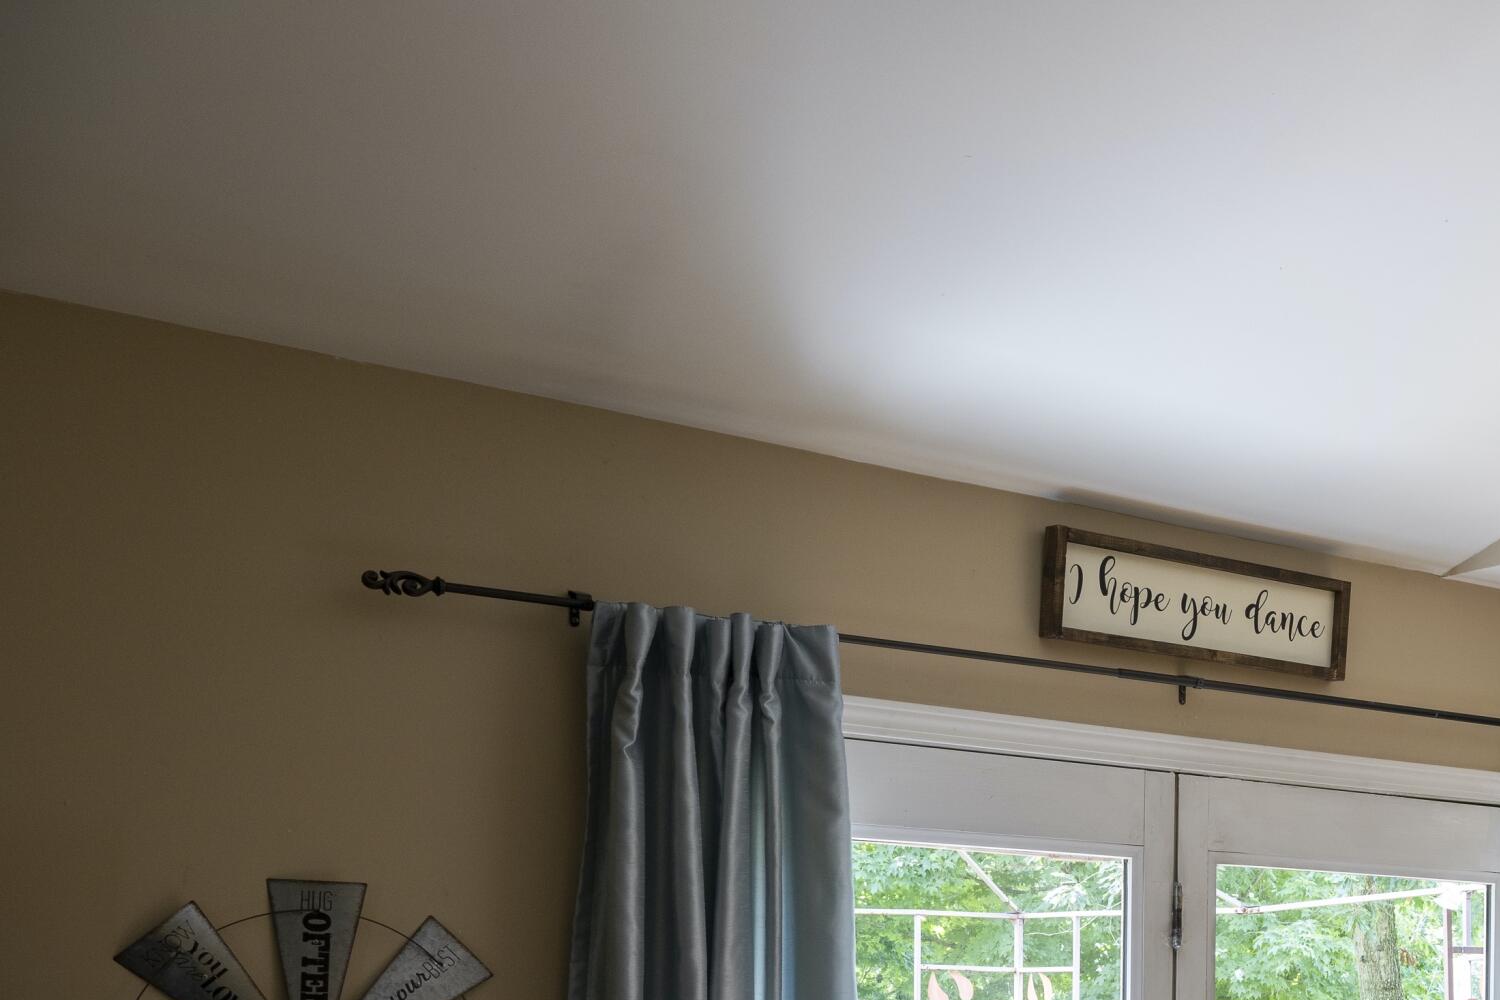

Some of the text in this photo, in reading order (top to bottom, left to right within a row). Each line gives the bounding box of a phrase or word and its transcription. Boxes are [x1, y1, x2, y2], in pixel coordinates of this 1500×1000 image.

[1099, 555, 1170, 625] hope
[1181, 593, 1232, 641] you
[1244, 589, 1326, 642] dance
[299, 890, 333, 912] HUG
[419, 944, 462, 980] BEST
